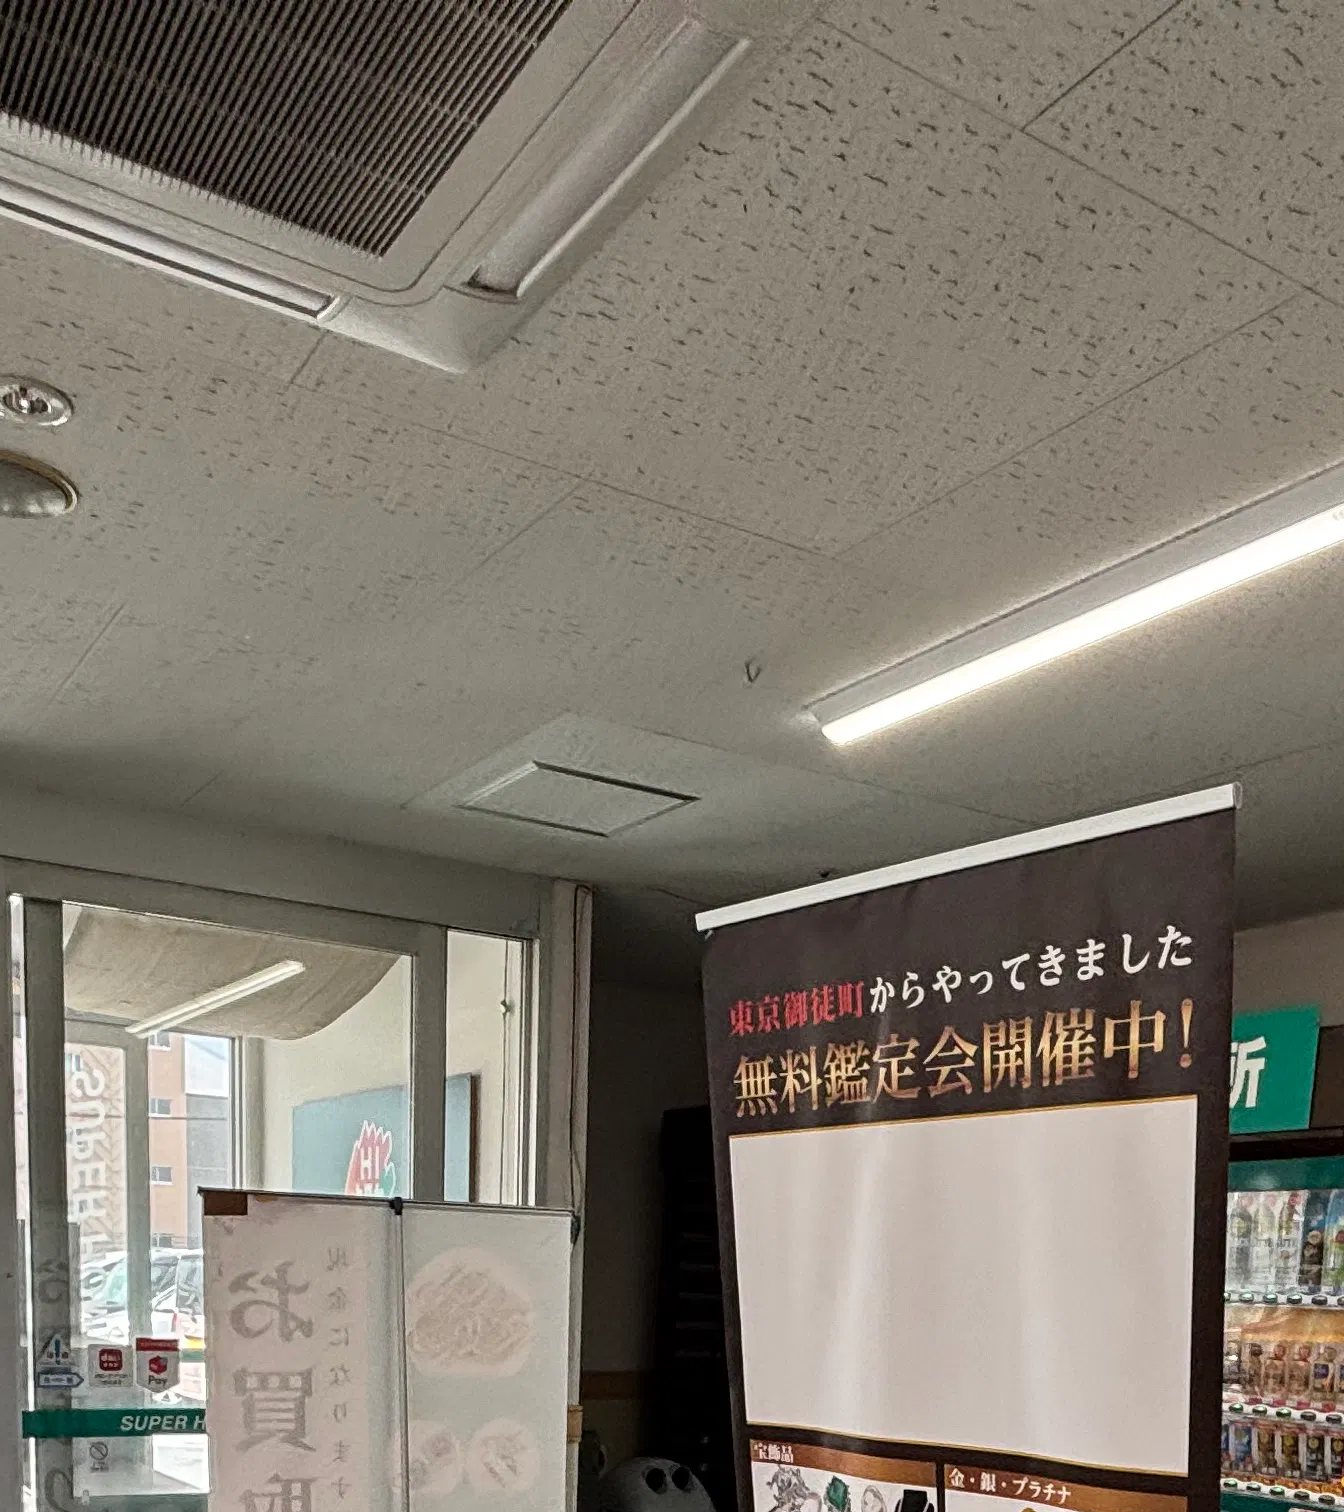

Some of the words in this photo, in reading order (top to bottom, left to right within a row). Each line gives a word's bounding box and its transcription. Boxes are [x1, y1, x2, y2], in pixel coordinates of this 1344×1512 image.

[729, 925, 1193, 1038] 東京御徒町からやってきました
[733, 998, 1194, 1118] 無料鑑定会開催中!
[119, 1414, 188, 1431] SUPER
[949, 1468, 1072, 1504] 金・銀・プラチナ
